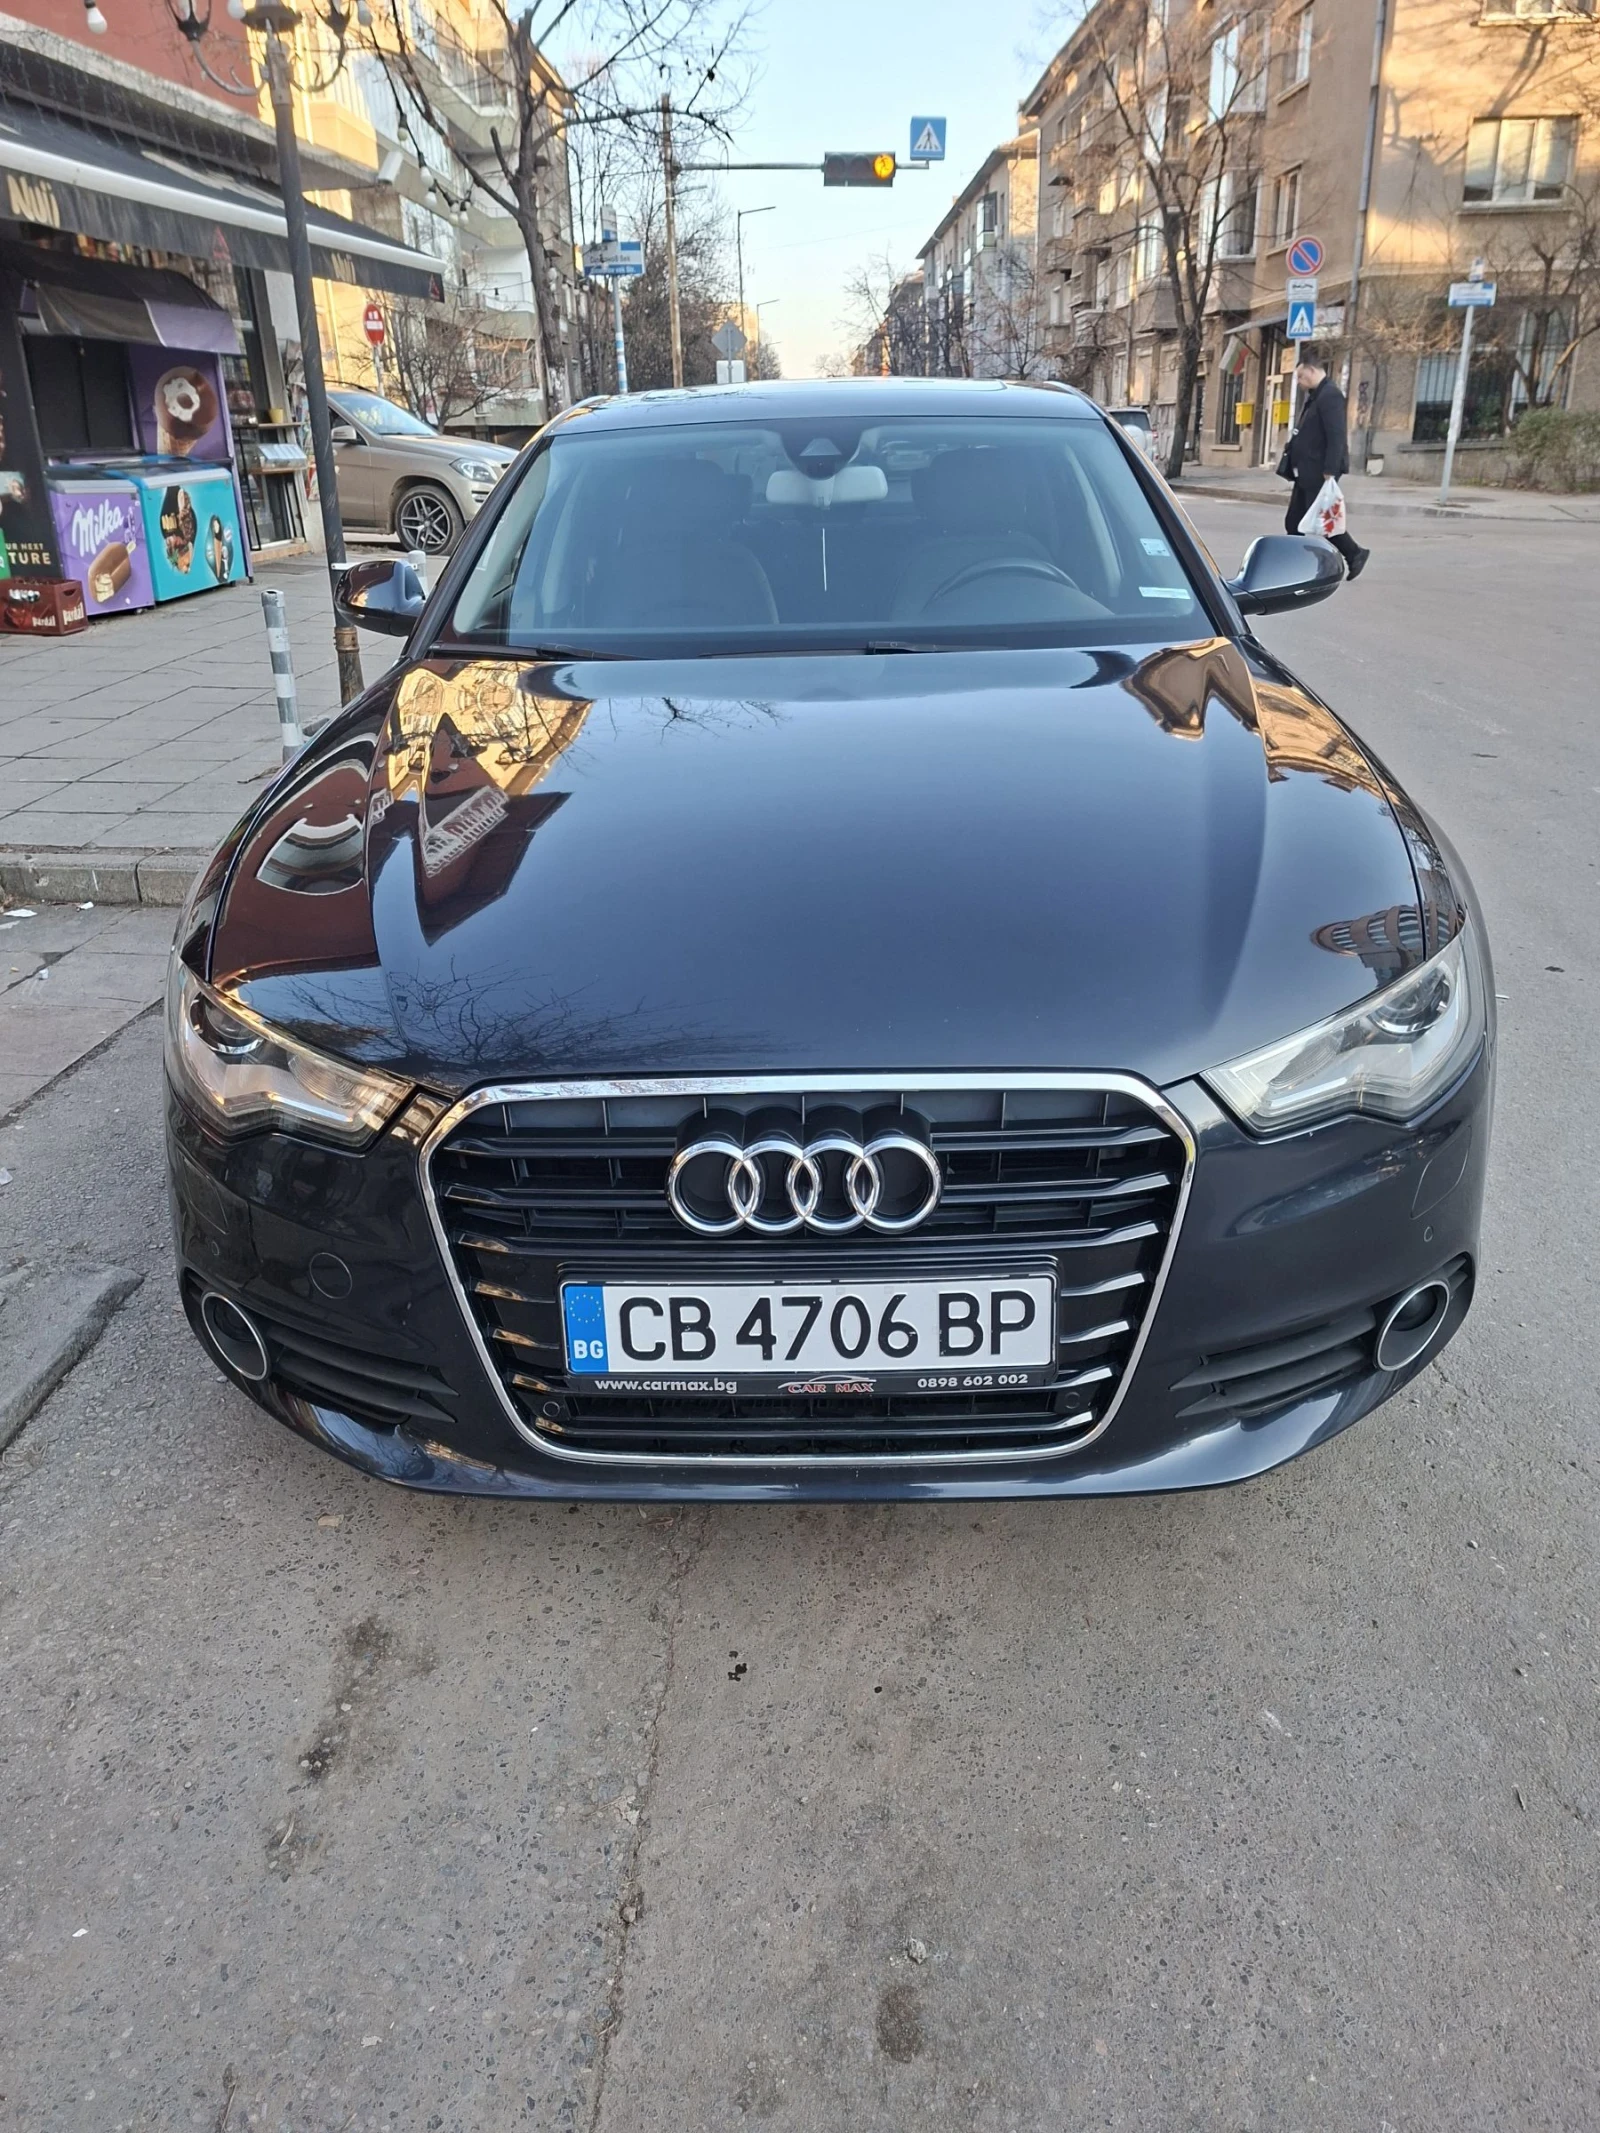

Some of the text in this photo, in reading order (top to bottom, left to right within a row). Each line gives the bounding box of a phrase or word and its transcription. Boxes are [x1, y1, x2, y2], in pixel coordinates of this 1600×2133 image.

[72, 499, 124, 557] Milka
[735, 1294, 919, 1361] 4706
[573, 1339, 604, 1360] BG
[594, 1378, 737, 1394] www.carmax.bg
[788, 1382, 875, 1394] CAR MAX
[917, 1374, 1029, 1389] 0898 602 002
